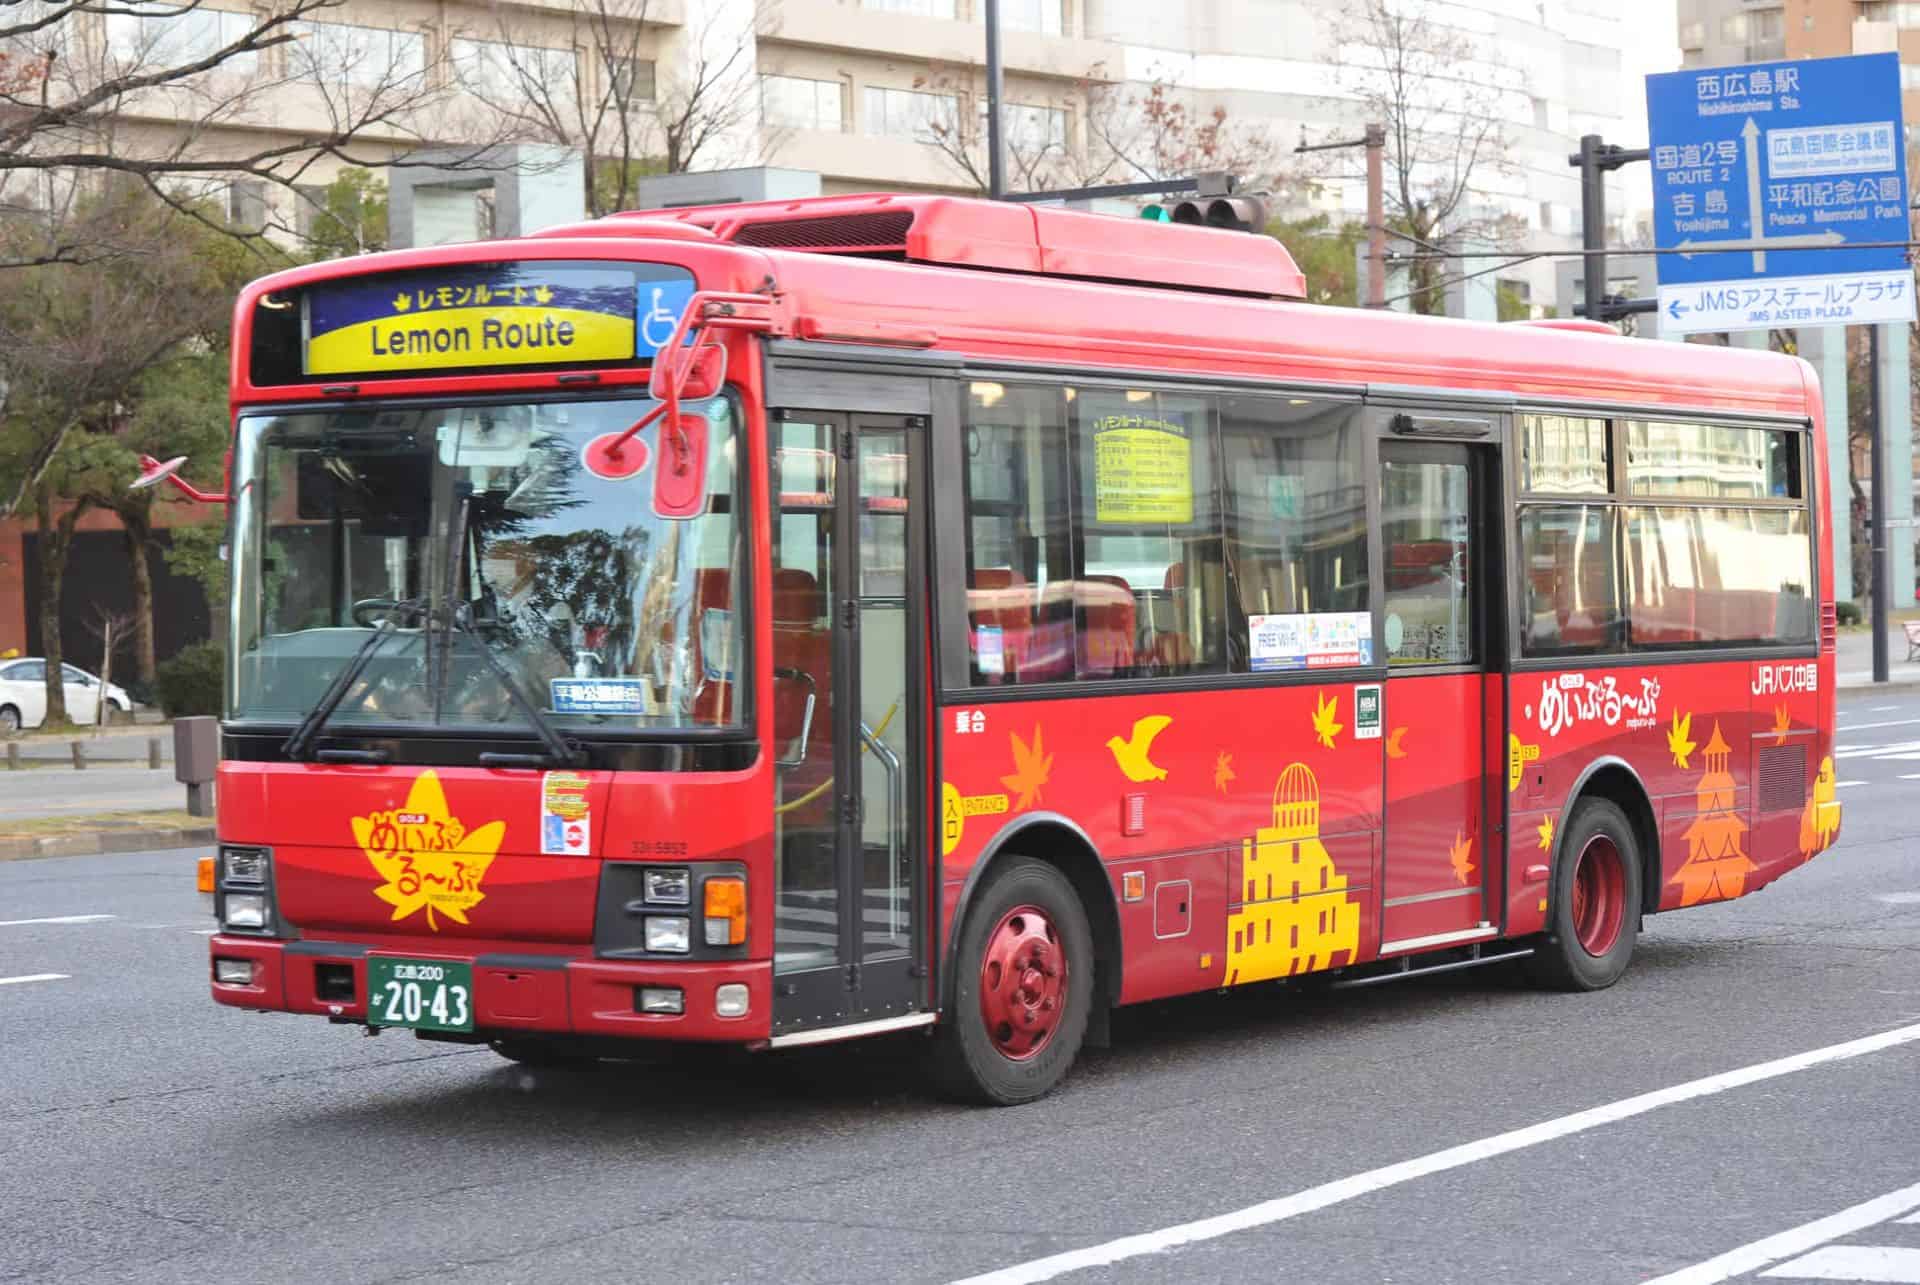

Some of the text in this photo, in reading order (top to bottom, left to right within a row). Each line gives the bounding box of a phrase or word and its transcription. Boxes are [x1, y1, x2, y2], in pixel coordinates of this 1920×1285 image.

[1696, 68, 1800, 100] 西広島駅
[1655, 140, 1738, 169] 国道2号
[1775, 128, 1889, 157] 広島国際会議場
[1667, 168, 1730, 184] ROUTE 2
[1672, 189, 1728, 216] 吉島
[1767, 177, 1901, 208] 平和記念公園
[1674, 218, 1729, 233] Yoshijima
[1769, 204, 1902, 225] Peace Memorial Park
[417, 284, 528, 309] レモンルート
[1694, 280, 1905, 312] JMSアステールプラザ
[1750, 304, 1853, 321] JMS ASTER PLAZA
[370, 316, 574, 355] Lemon Route
[1751, 664, 1817, 695] JRバス中国
[946, 799, 958, 838] 入口
[384, 980, 468, 1025] 20-43
